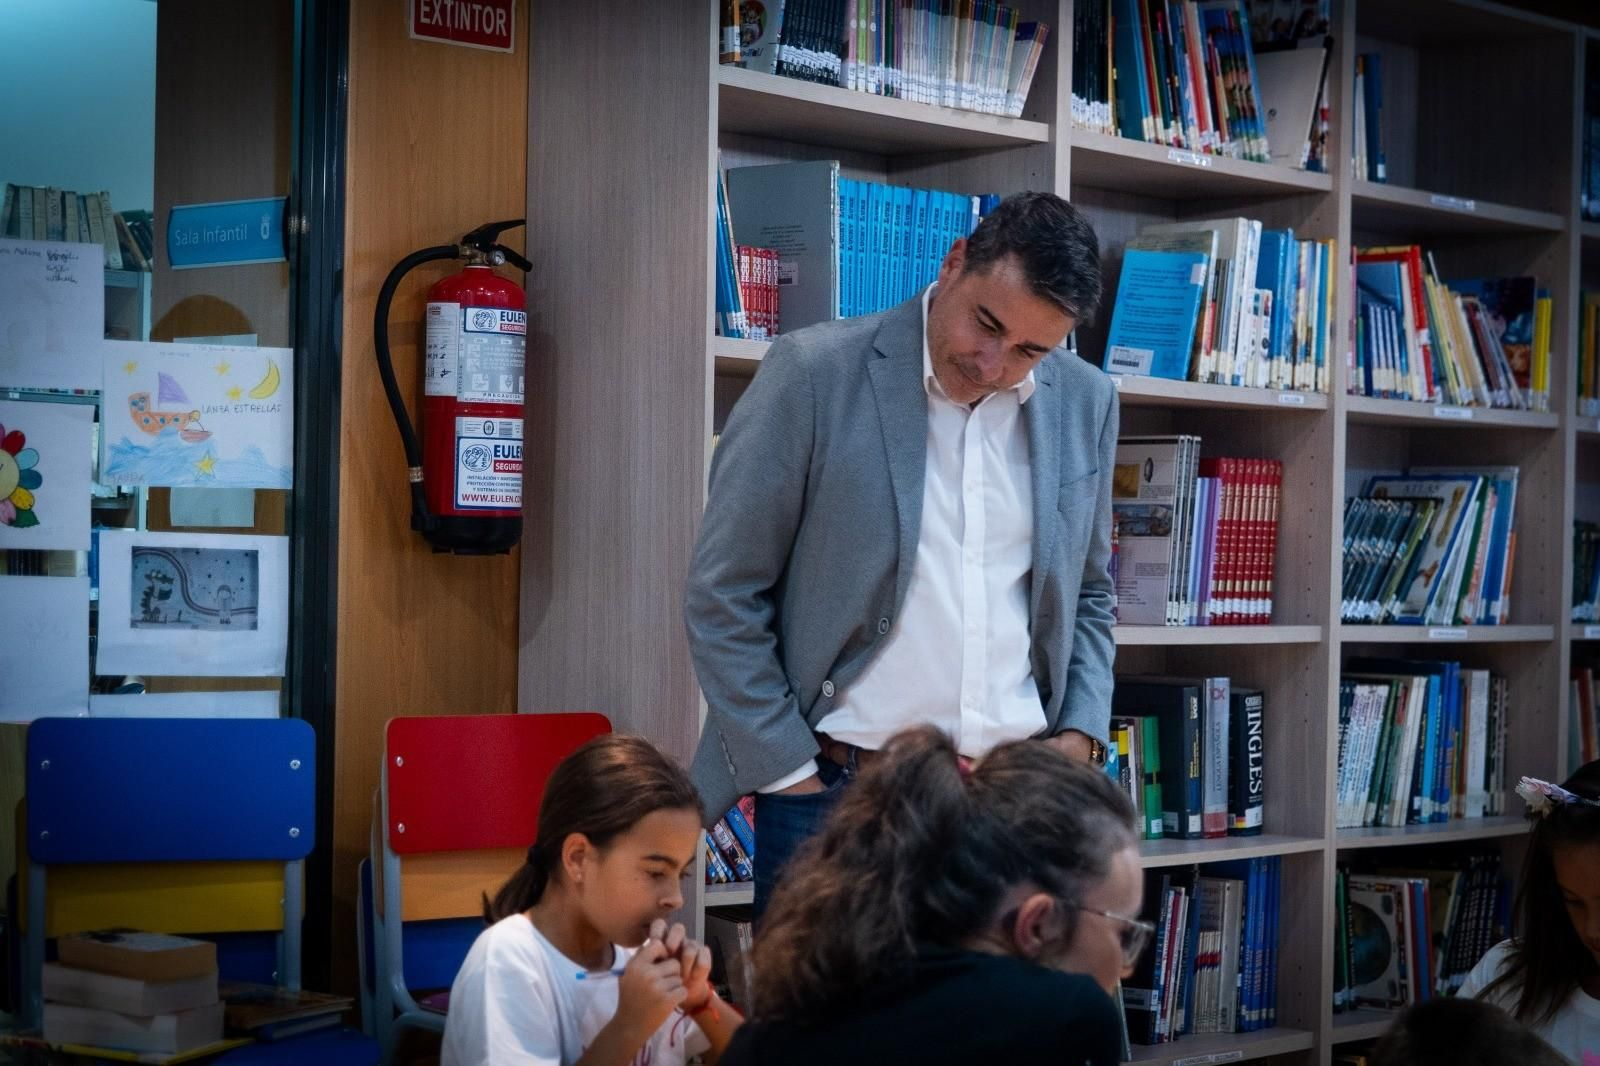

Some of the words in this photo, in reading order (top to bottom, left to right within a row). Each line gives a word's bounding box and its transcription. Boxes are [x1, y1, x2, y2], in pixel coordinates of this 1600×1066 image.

[420, 0, 507, 37] EXTINTOR
[175, 229, 199, 246] Sala
[202, 223, 248, 244] Infantil
[500, 311, 526, 324] EULEN
[1247, 711, 1263, 794] INGLES
